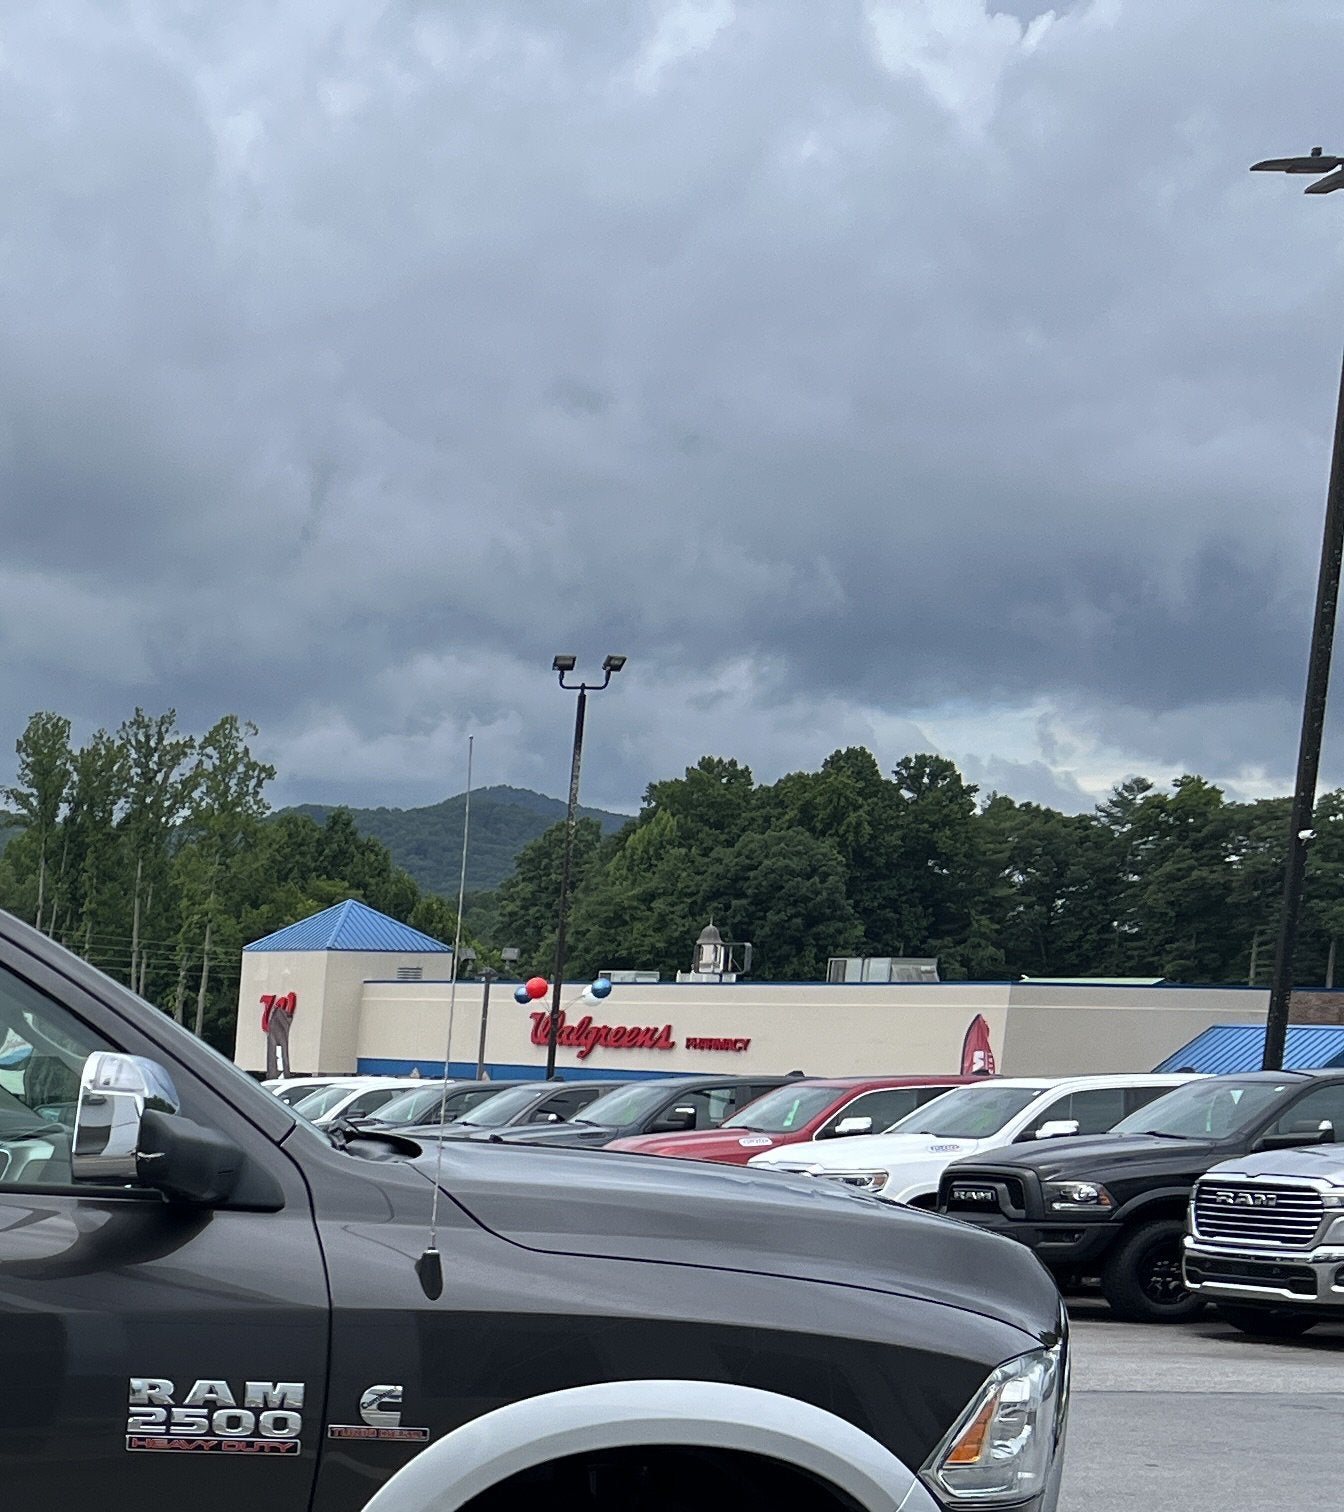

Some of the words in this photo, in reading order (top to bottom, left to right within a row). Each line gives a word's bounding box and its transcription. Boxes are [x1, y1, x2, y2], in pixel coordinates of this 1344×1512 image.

[529, 1010, 676, 1061] Walgreens
[953, 1190, 994, 1201] RAM
[1215, 1191, 1278, 1206] RAM
[128, 1377, 305, 1409] RAM
[126, 1406, 303, 1438] 2500
[131, 1437, 219, 1451] HEAVY
[221, 1440, 295, 1453] DUTY
